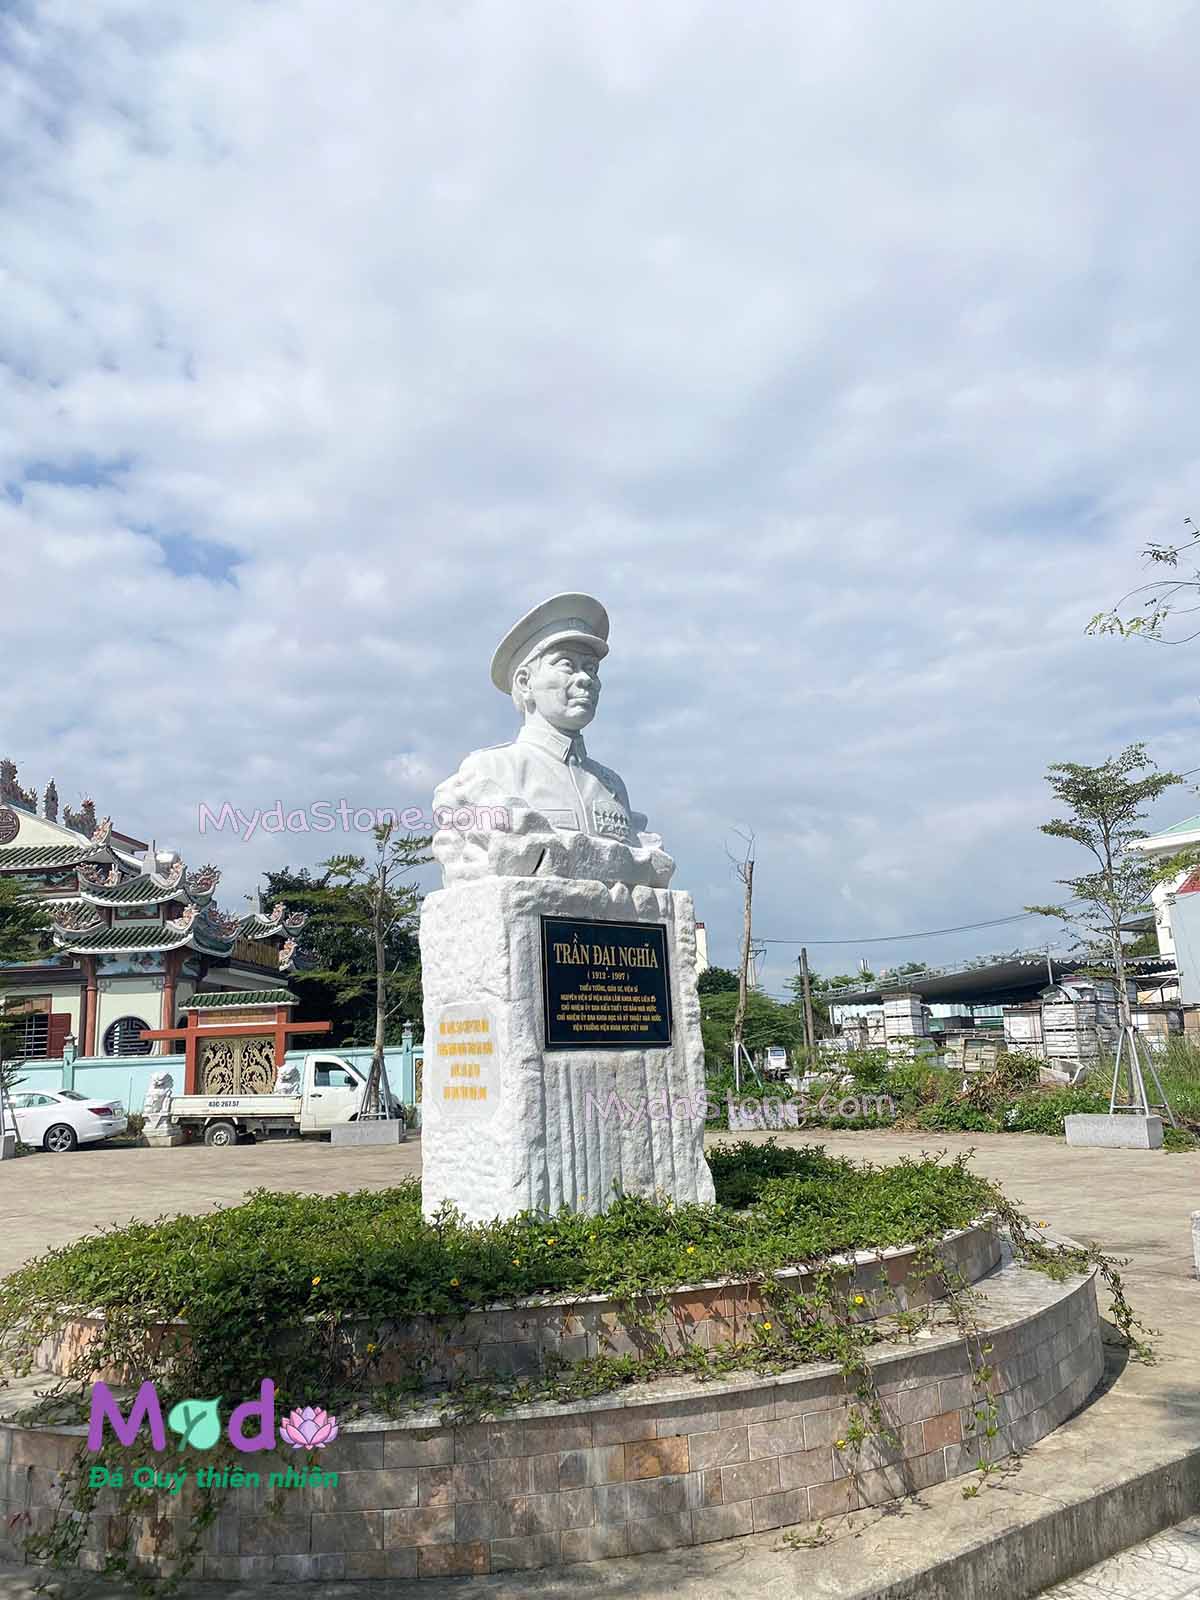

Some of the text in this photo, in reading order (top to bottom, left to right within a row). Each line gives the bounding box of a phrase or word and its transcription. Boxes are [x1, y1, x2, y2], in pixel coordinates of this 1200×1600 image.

[553, 932, 659, 971] TRẦN ĐẠI NGHĨA
